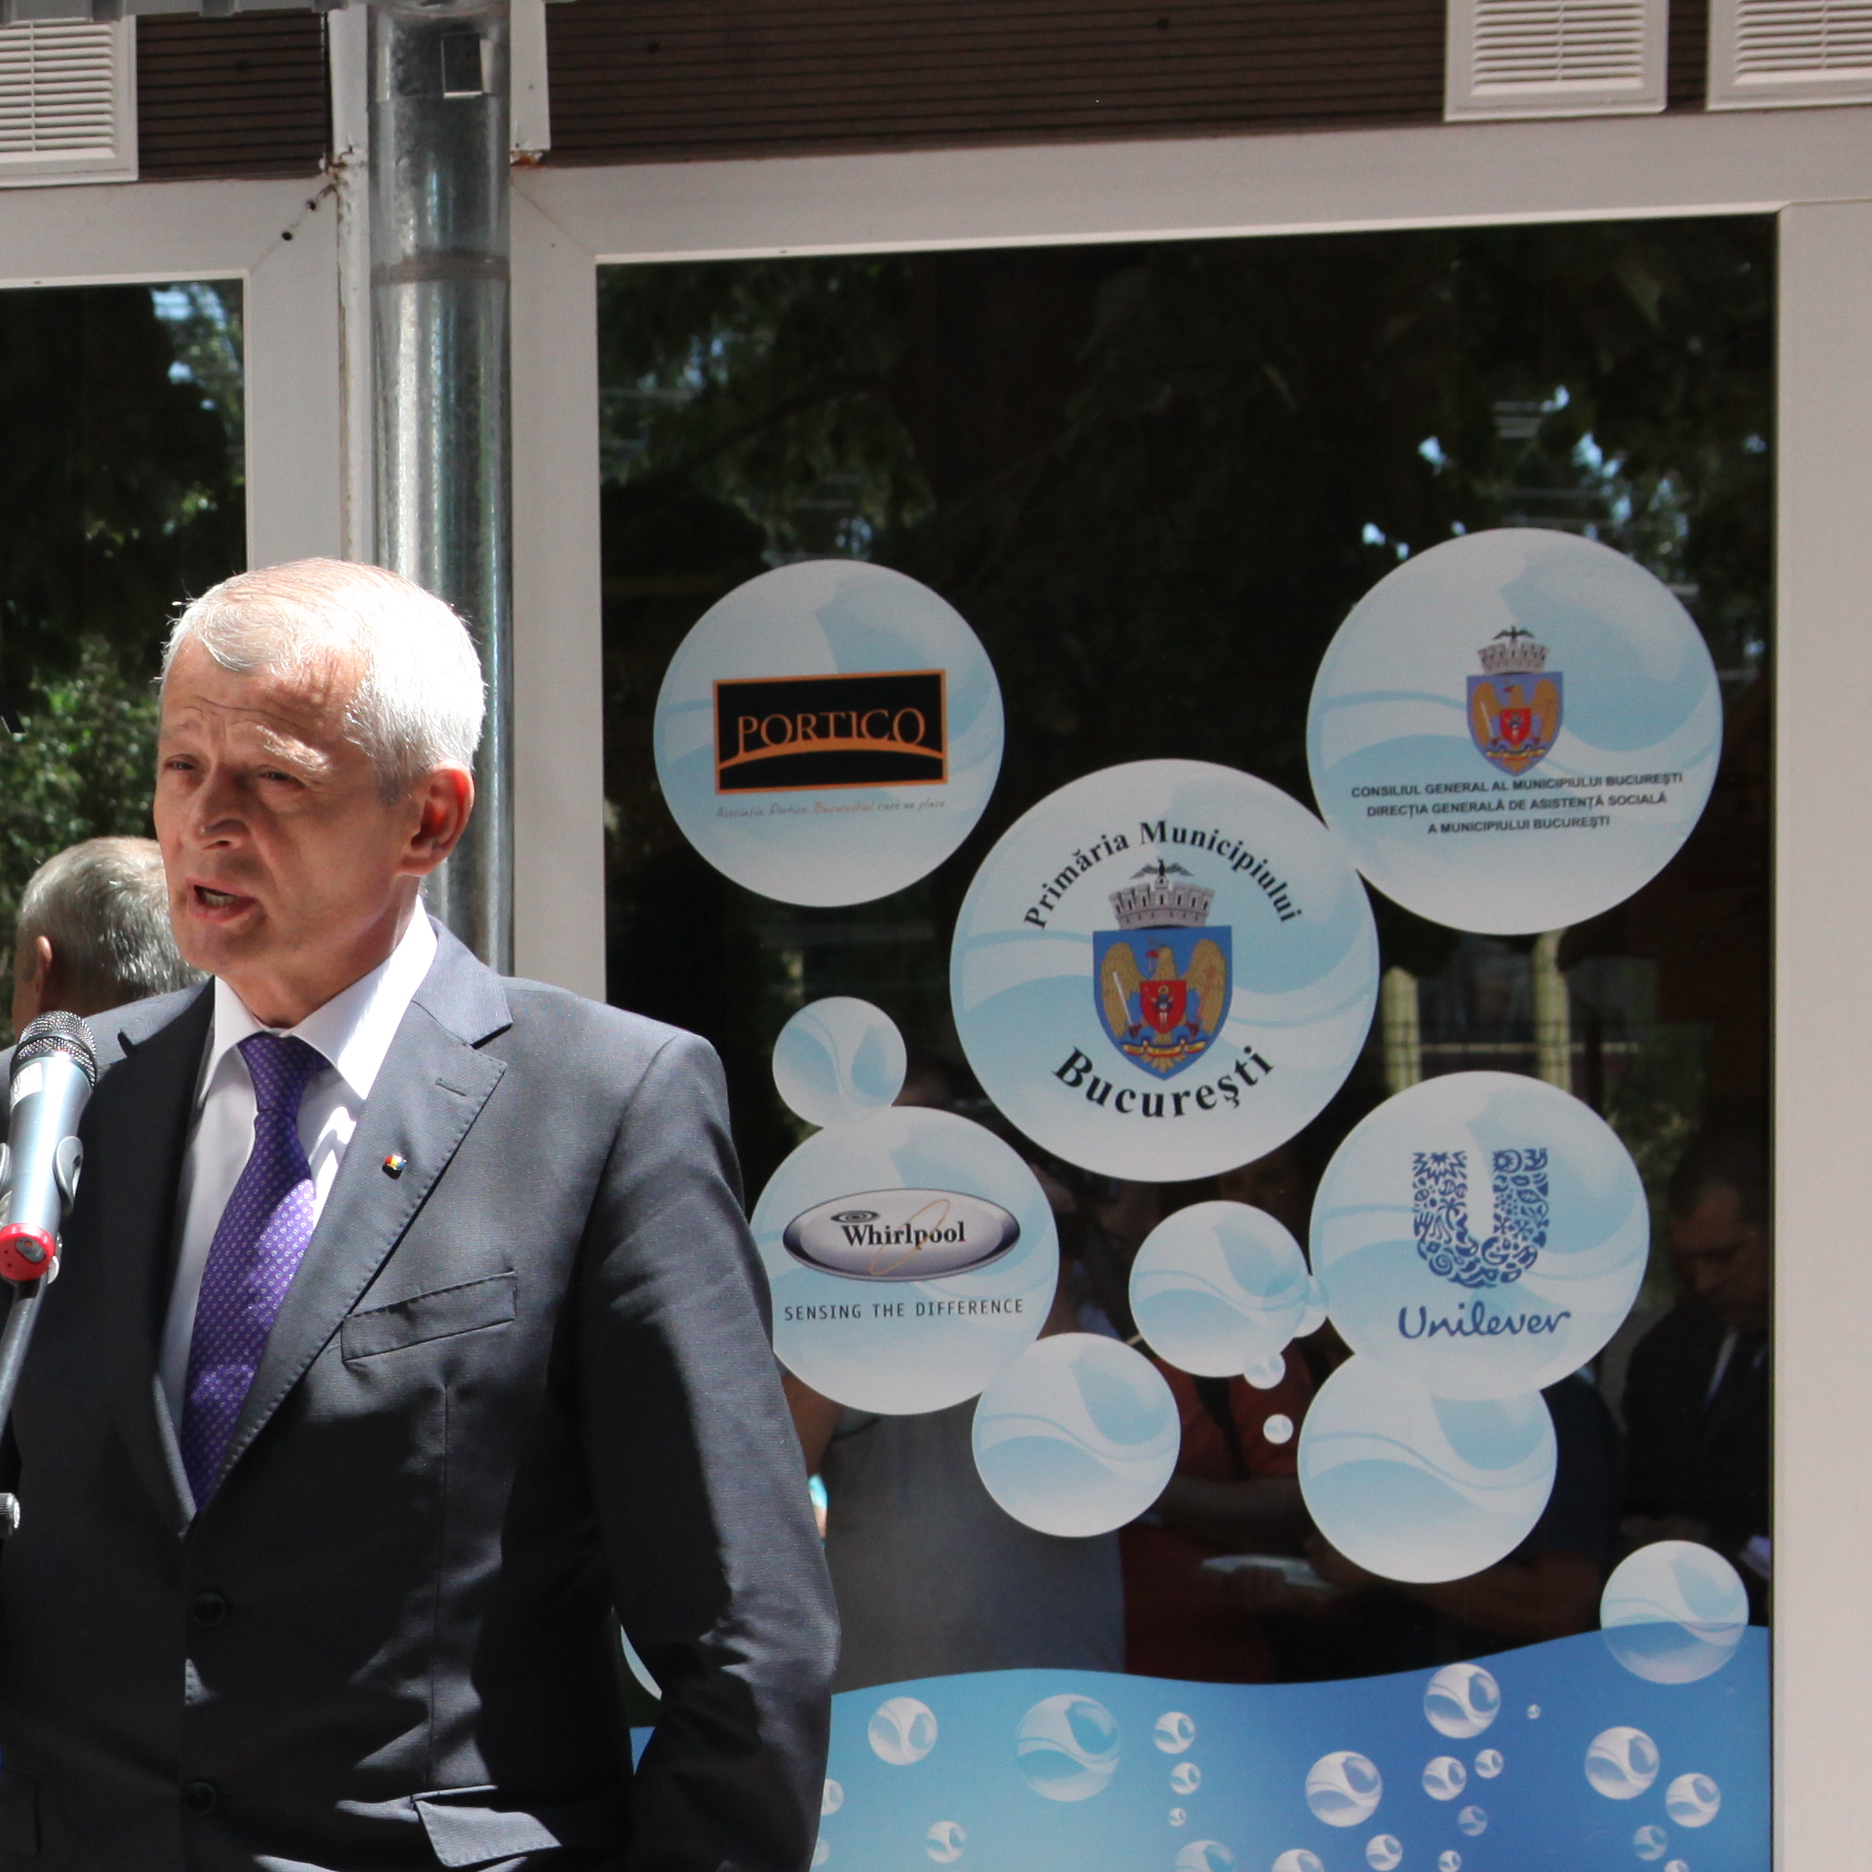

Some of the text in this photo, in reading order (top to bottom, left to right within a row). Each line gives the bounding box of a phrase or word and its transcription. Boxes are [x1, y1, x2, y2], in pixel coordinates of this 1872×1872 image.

[738, 707, 926, 752] PORTICO
[1351, 785, 1421, 798] CONSILIUL
[1425, 782, 1489, 795] GENERAL
[1492, 780, 1508, 792] AL
[1512, 776, 1603, 791] MUNICIPIULUI
[1431, 798, 1505, 814] GENERALĂ
[1509, 799, 1527, 812] DE
[1608, 791, 1668, 807] SOCIALĂ
[1427, 824, 1438, 835] A
[1440, 819, 1530, 834] MUNICIPIULUI
[1024, 820, 1303, 929] Primăria Municipiului
[841, 1221, 966, 1250] Whirlpool
[784, 1298, 1023, 1321] SENSING THE DIFFERENCE
[1398, 1300, 1571, 1339] Unilever
